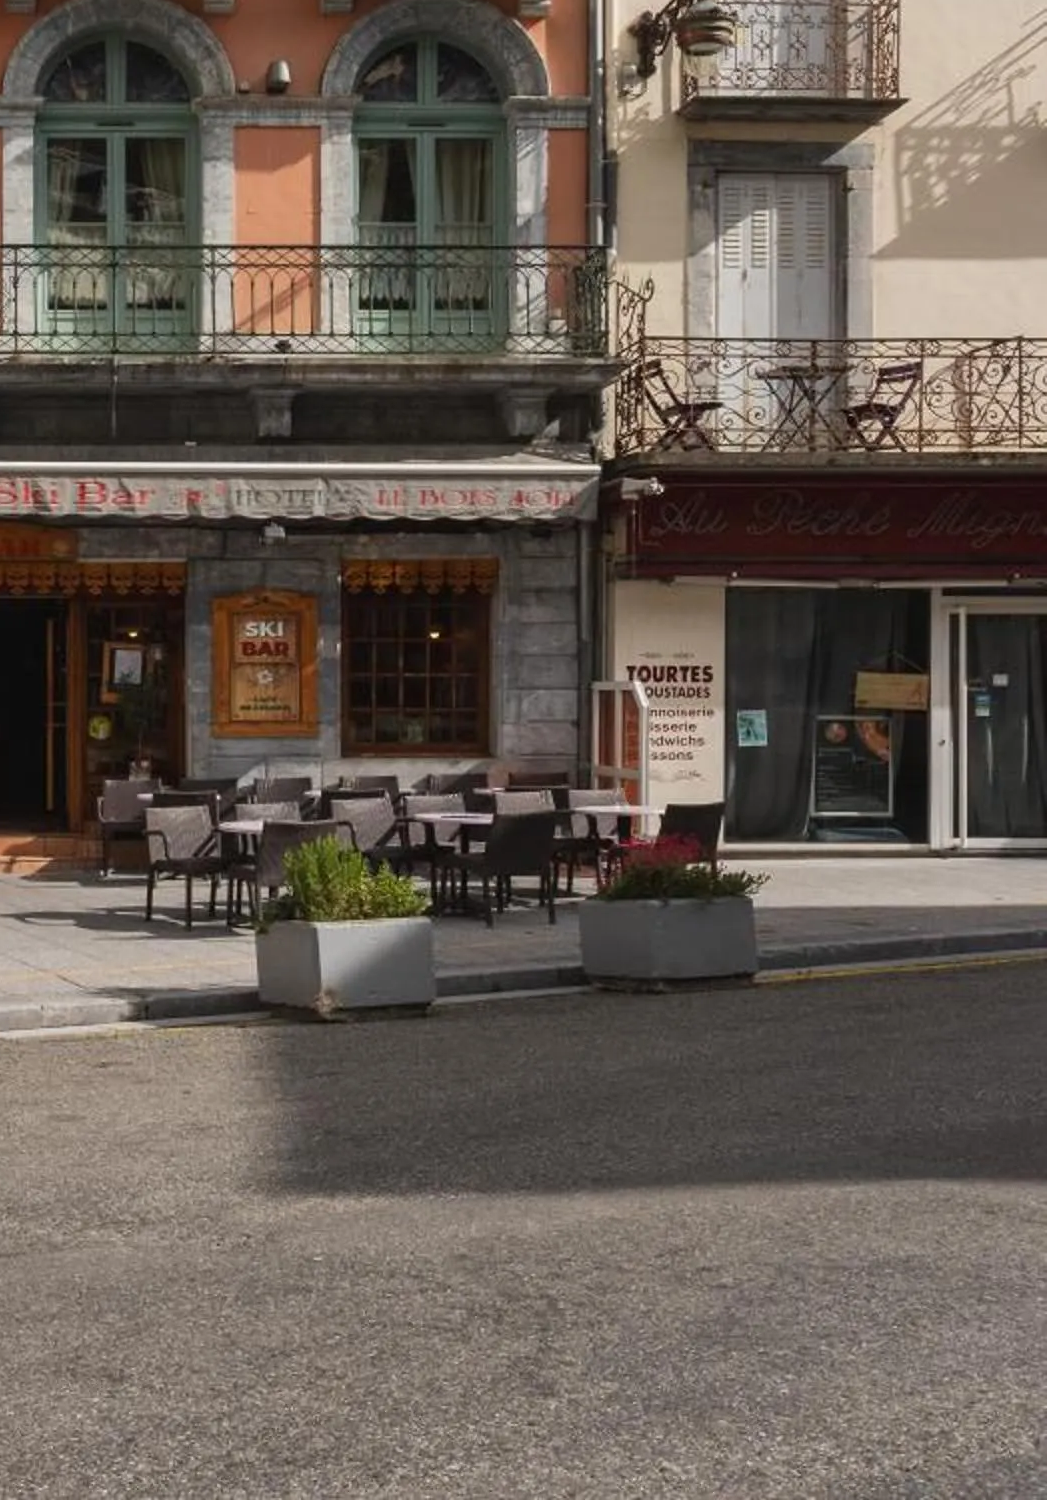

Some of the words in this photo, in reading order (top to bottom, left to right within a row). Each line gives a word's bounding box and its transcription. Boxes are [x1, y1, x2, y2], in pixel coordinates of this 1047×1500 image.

[906, 489, 1046, 549] Mign
[245, 620, 284, 637] SKI
[241, 640, 290, 657] BAR
[626, 665, 714, 682] TOURTES
[644, 686, 711, 699] OUSTADES
[649, 707, 714, 717] nnoiserie
[650, 722, 697, 732] isserie
[651, 751, 694, 761] ssons
